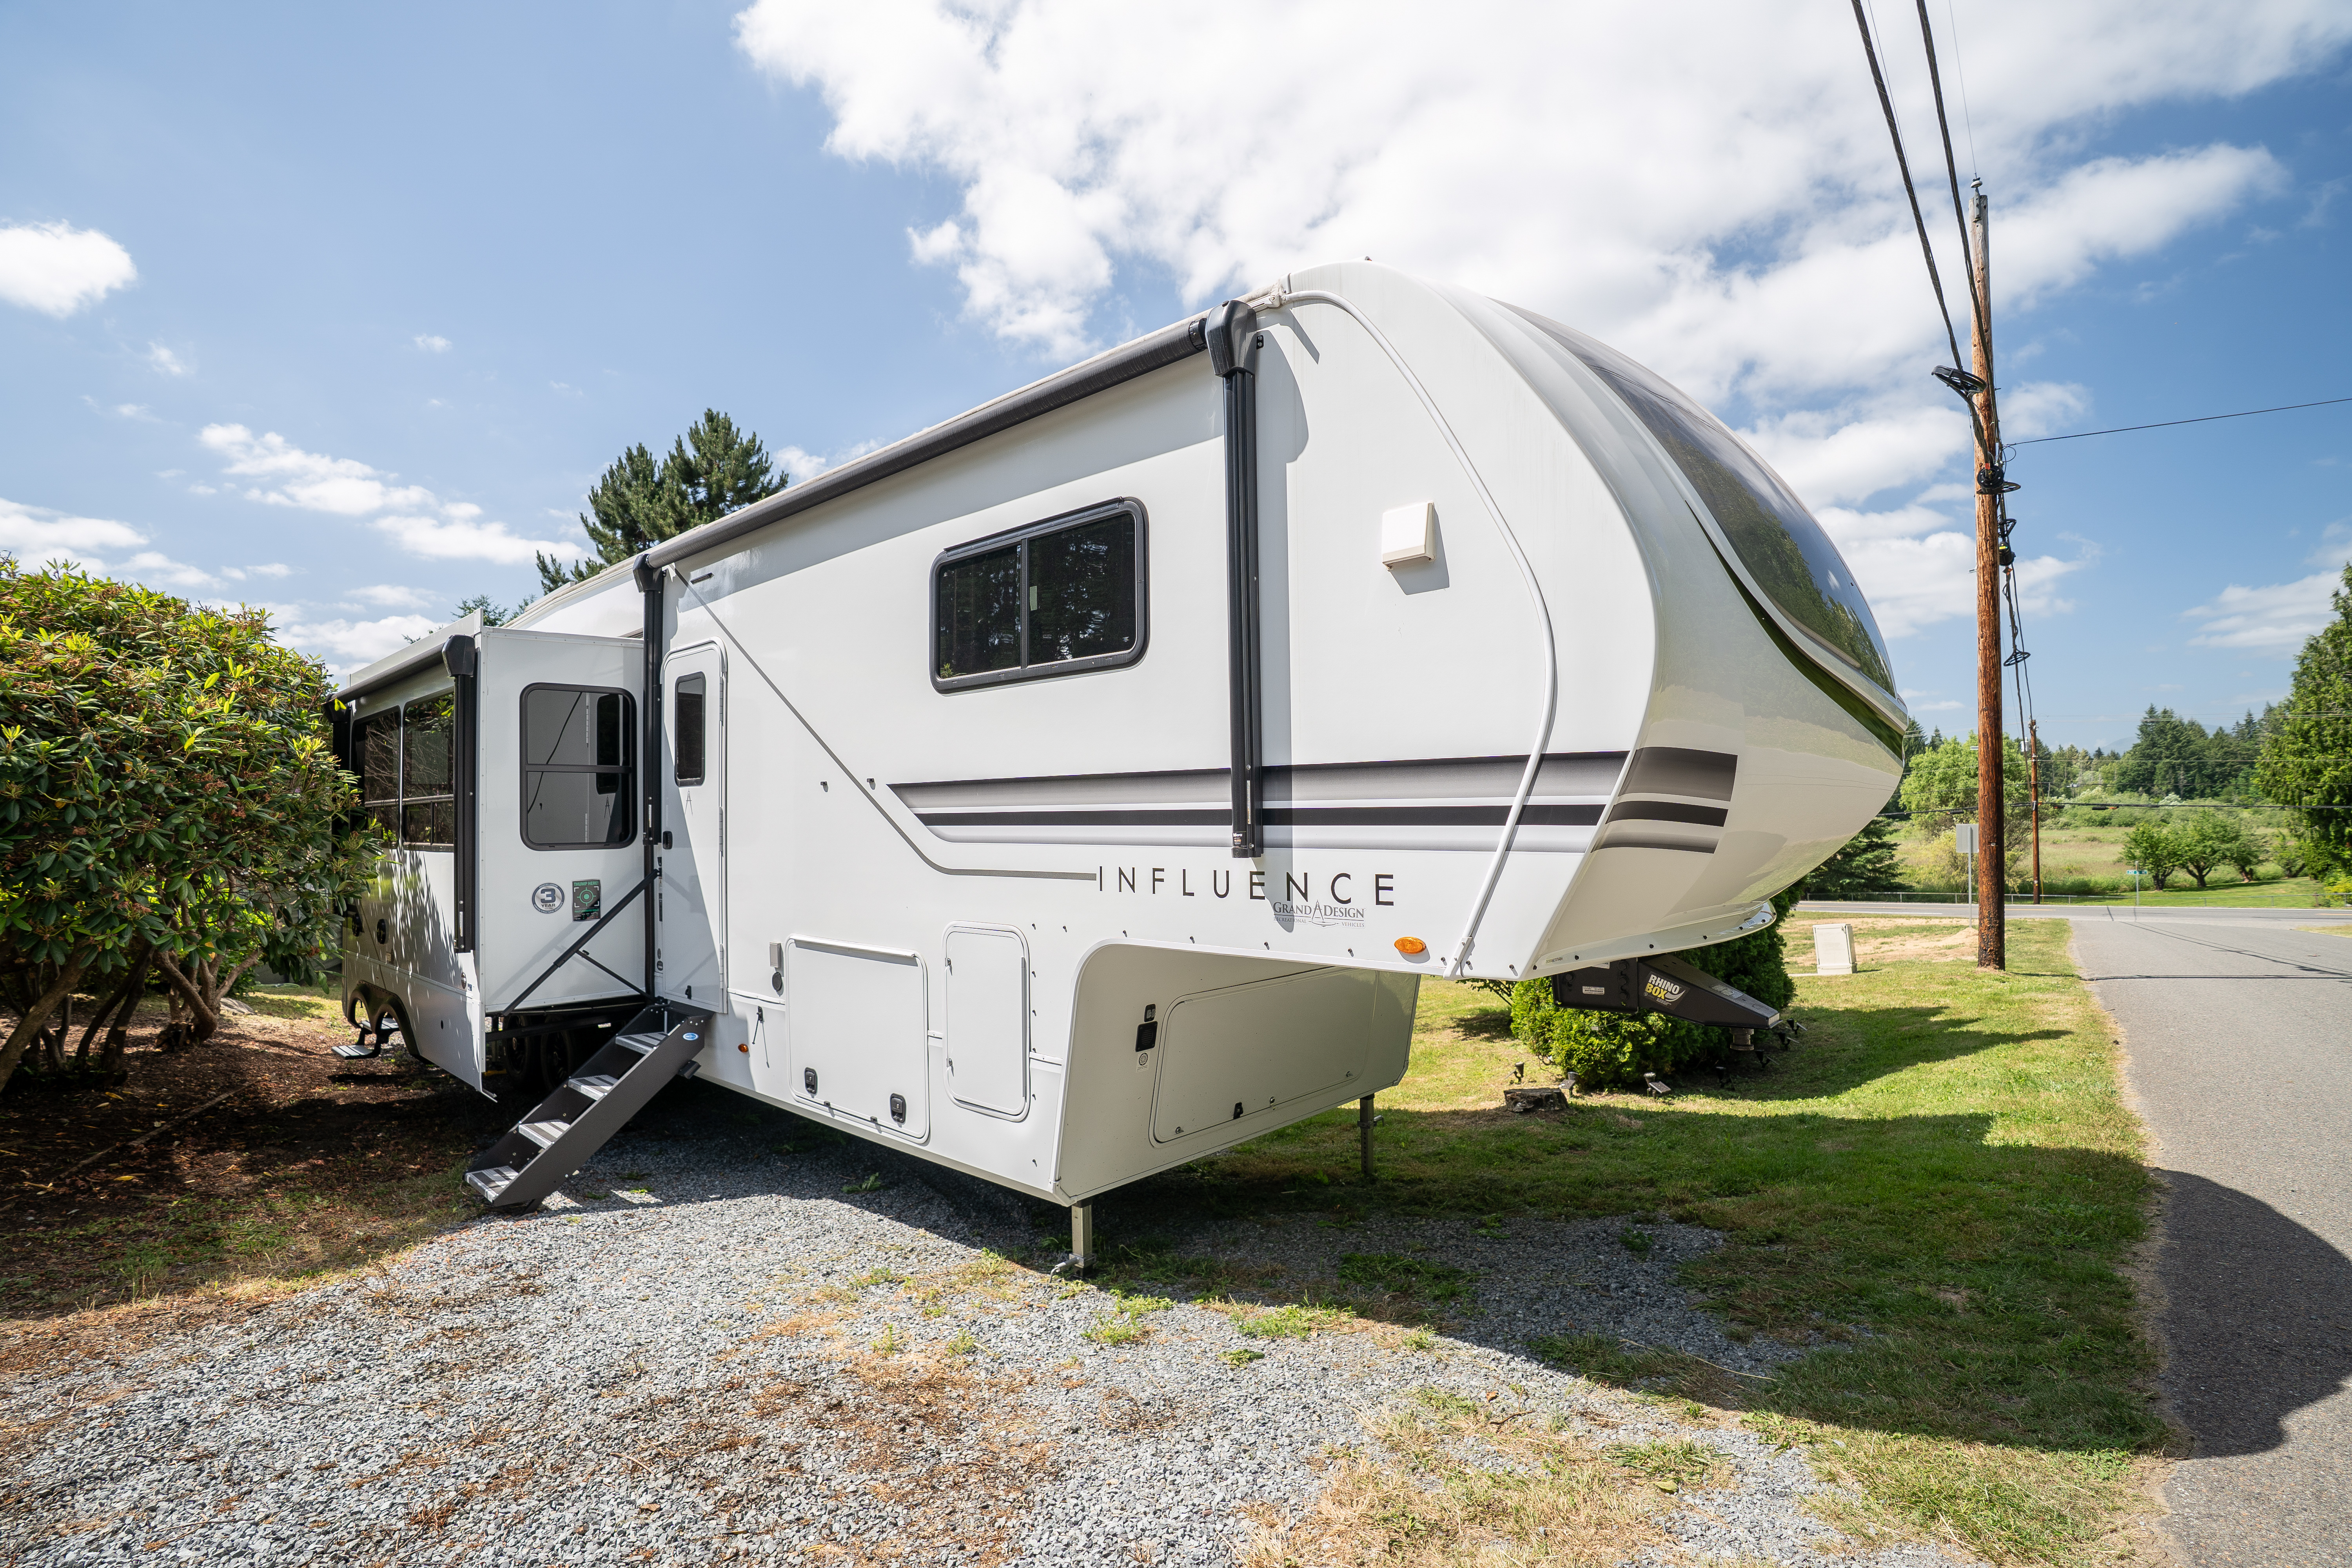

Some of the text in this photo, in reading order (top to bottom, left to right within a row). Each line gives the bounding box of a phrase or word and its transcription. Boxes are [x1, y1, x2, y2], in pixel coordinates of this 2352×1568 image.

[1100, 866, 1394, 906] INFLUENCE
[541, 888, 556, 903] 3
[1273, 902, 1365, 918] GRAND DESIGN
[1645, 983, 1668, 1000] BOX
[1648, 974, 1680, 994] RHINO
